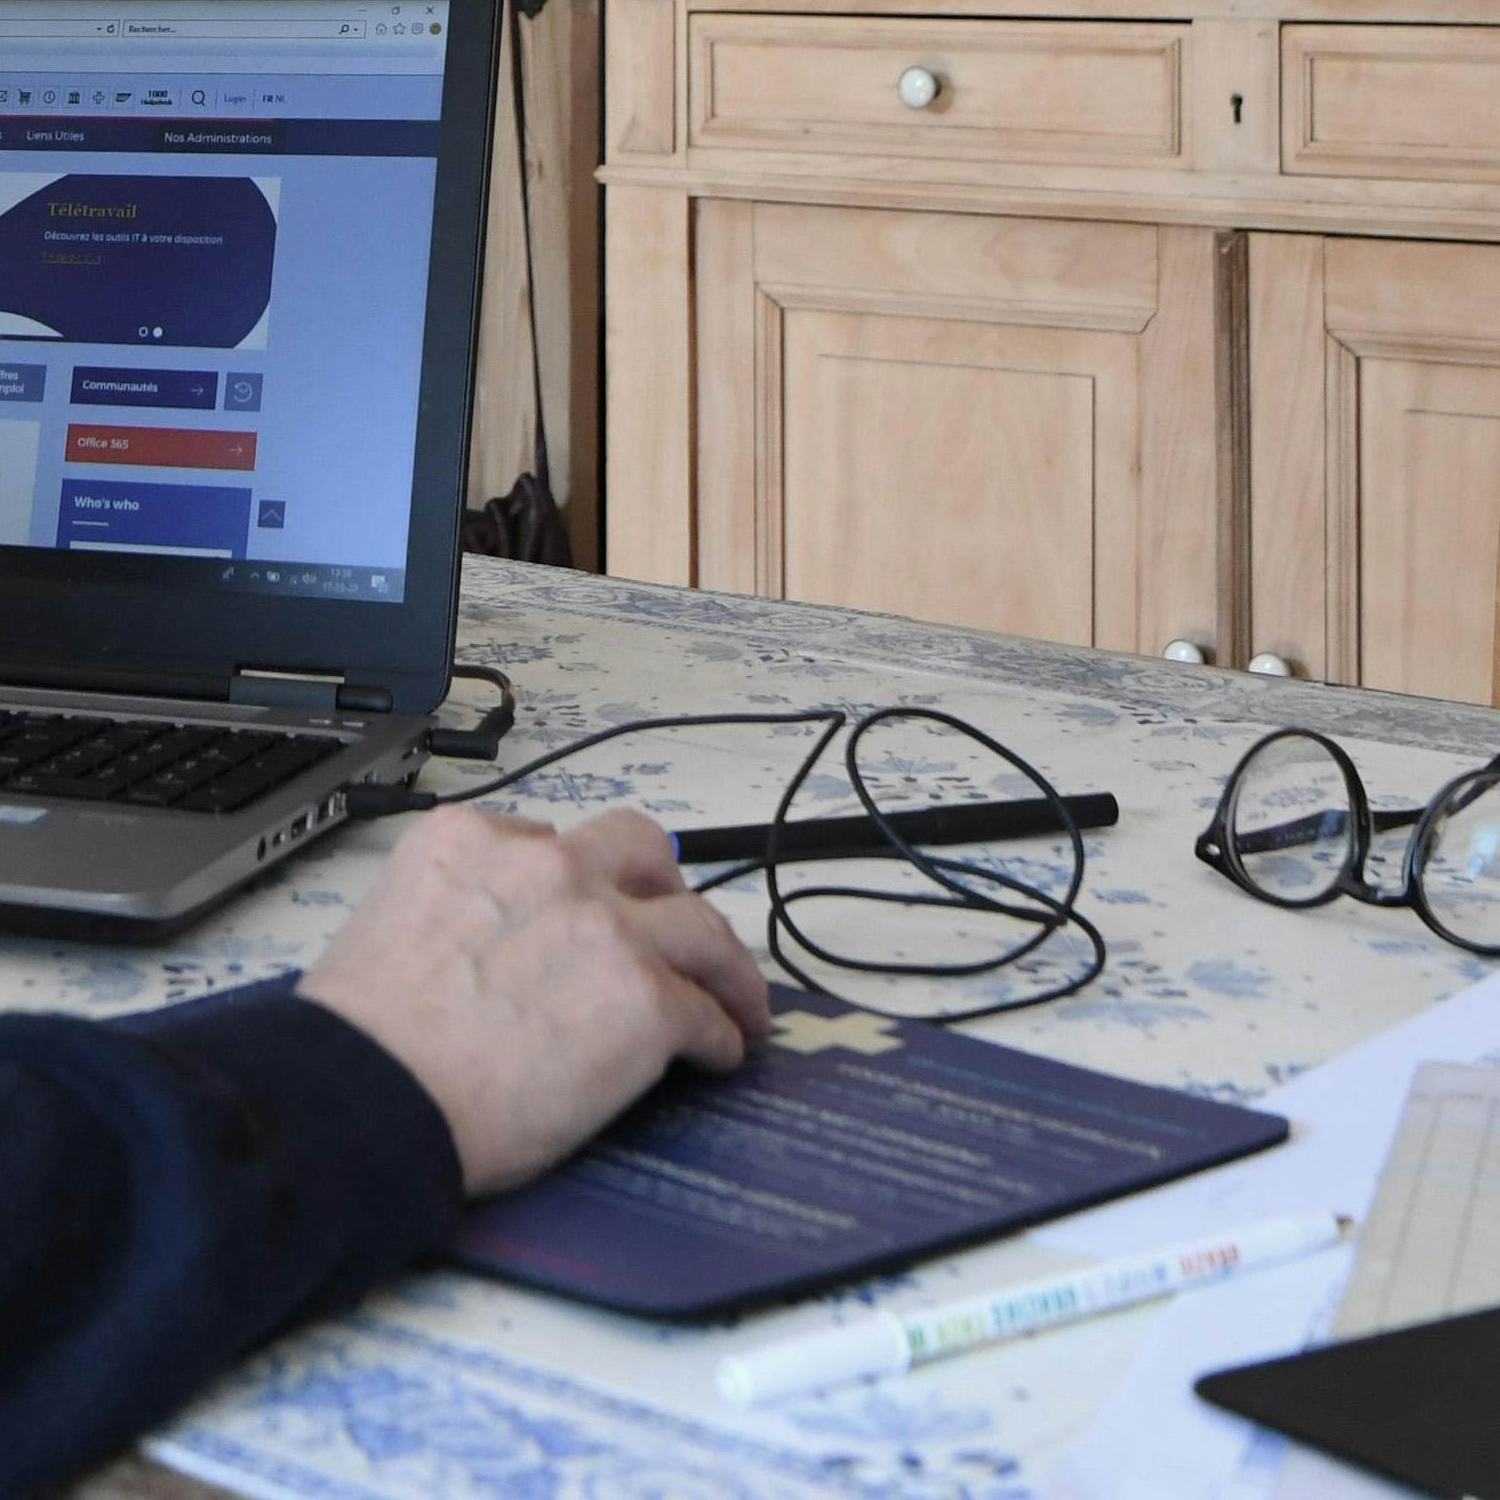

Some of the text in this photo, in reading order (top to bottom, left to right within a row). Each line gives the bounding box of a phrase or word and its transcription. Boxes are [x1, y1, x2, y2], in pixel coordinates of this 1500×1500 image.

[26, 130, 85, 142] Liens Utiles
[164, 132, 272, 144] Nos Administrations
[47, 201, 138, 219] Télétravail
[44, 230, 90, 242] Découvrez
[91, 231, 104, 242] les
[105, 232, 130, 243] outils
[149, 235, 173, 244] votre
[174, 234, 223, 246] disposition
[81, 379, 159, 393] Communautés
[77, 436, 130, 450] Office 365
[73, 495, 140, 511] Who's who
